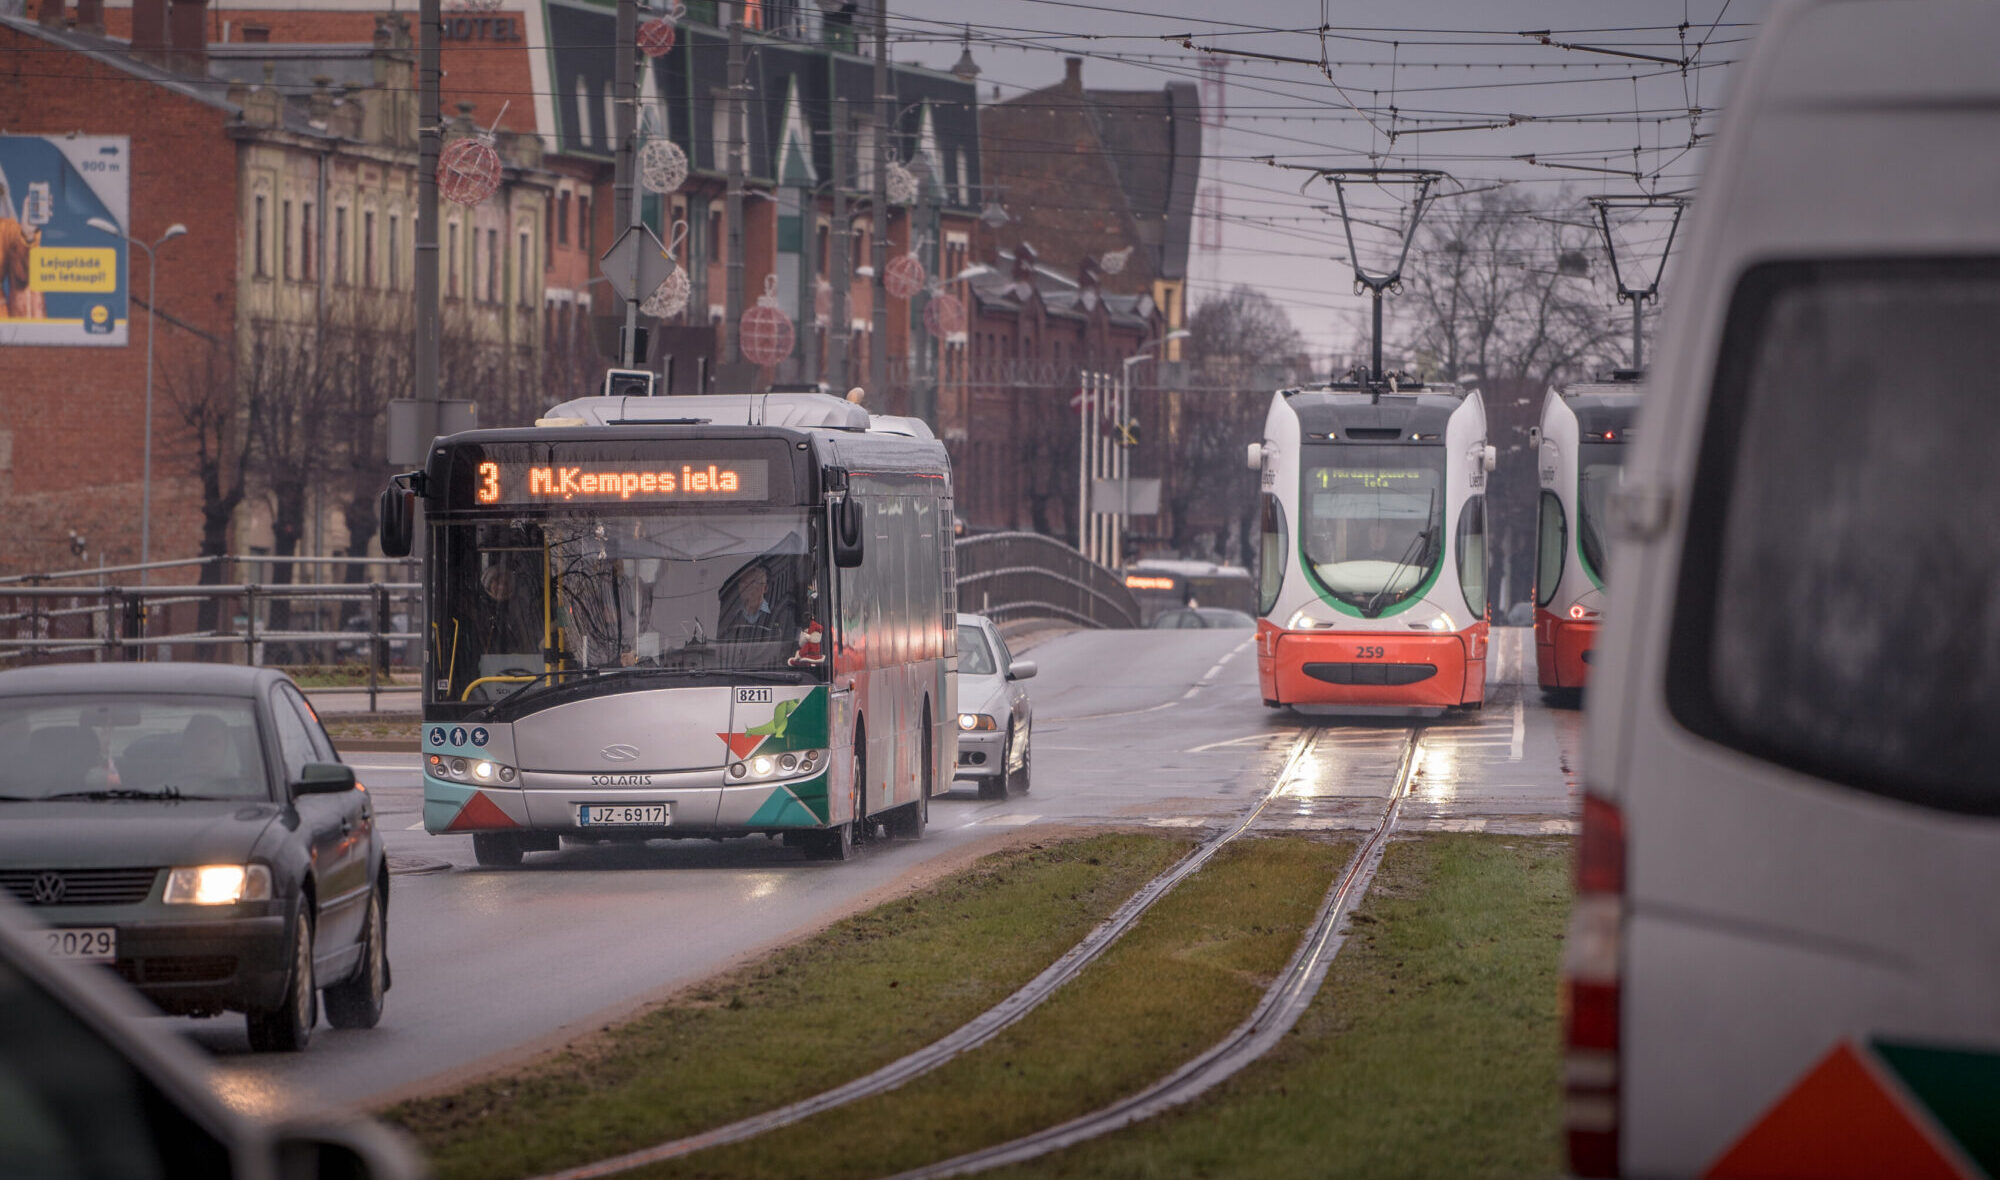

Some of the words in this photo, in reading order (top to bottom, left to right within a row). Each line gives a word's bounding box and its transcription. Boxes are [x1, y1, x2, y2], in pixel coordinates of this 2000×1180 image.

[82, 161, 106, 172] 900
[109, 163, 120, 172] m
[40, 272, 56, 282] un
[59, 271, 106, 285] ietaupi!
[479, 462, 499, 501] 3
[530, 465, 676, 500] M.Ķempes
[682, 465, 738, 492] iela
[1356, 646, 1385, 658] 259
[740, 689, 768, 701] 8211
[591, 775, 652, 786] SOLARIS
[592, 808, 662, 822] JZ-6917
